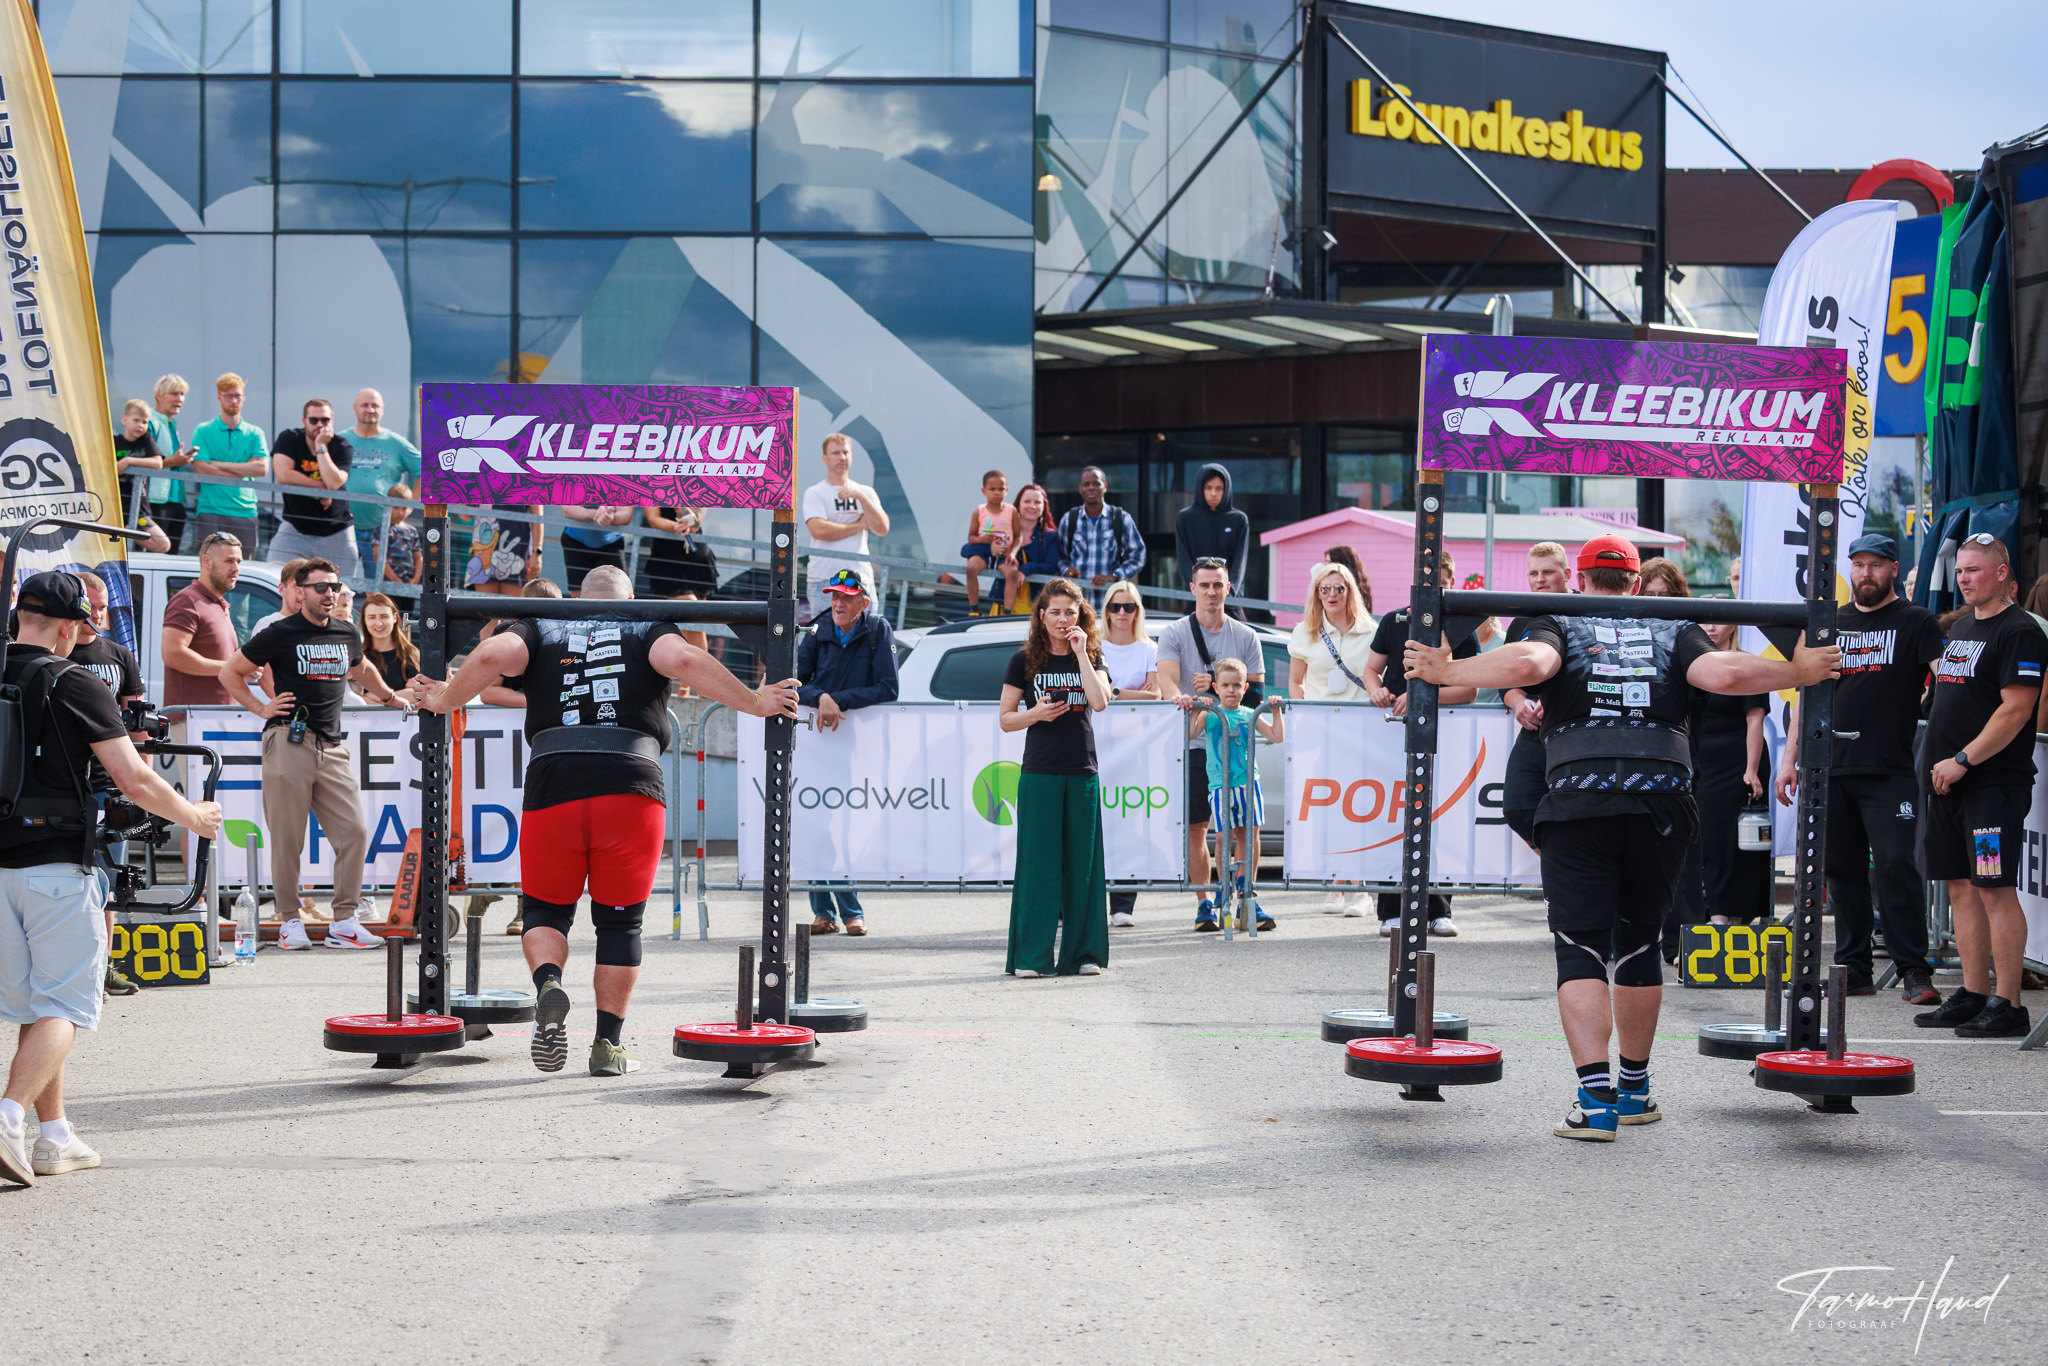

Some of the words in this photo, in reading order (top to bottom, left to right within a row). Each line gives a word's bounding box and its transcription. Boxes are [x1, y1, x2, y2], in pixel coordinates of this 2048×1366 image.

[1352, 78, 1644, 171] Lõunakeskus
[1883, 273, 1928, 385] 5
[1847, 316, 1870, 398] koos!
[1543, 382, 1828, 430] KLEEBIKUM
[1852, 404, 1869, 439] on
[527, 423, 777, 461] KLEEBIKUM
[1695, 429, 1805, 446] REKLAAM
[660, 463, 758, 476] REKLAAM
[1840, 447, 1868, 518] Kõik
[1034, 673, 1084, 690] STRONGM
[1103, 786, 1169, 818] upp
